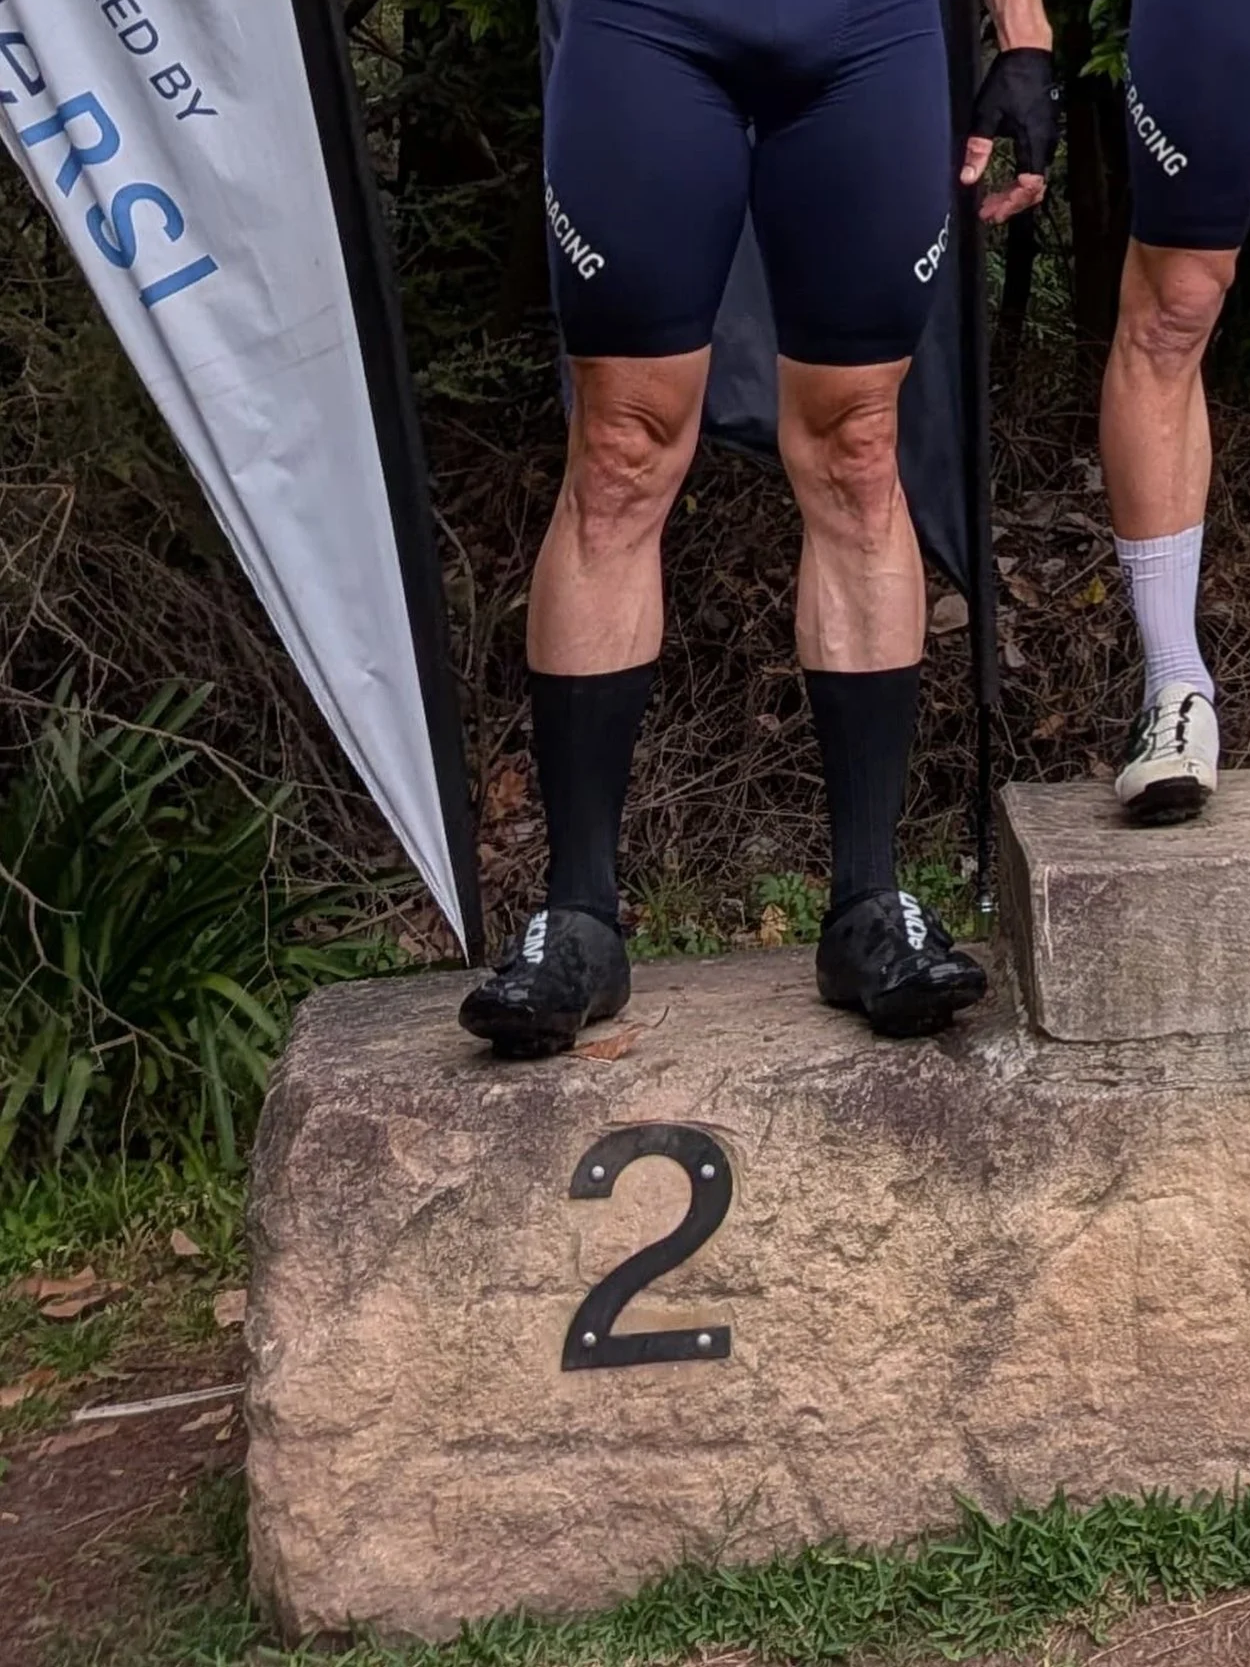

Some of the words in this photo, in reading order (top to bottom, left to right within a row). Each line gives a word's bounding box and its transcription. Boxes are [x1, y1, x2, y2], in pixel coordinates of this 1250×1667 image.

[149, 61, 219, 122] BY
[1126, 84, 1188, 177] RACING
[545, 184, 605, 280] RACING
[561, 1123, 733, 1372] 2
